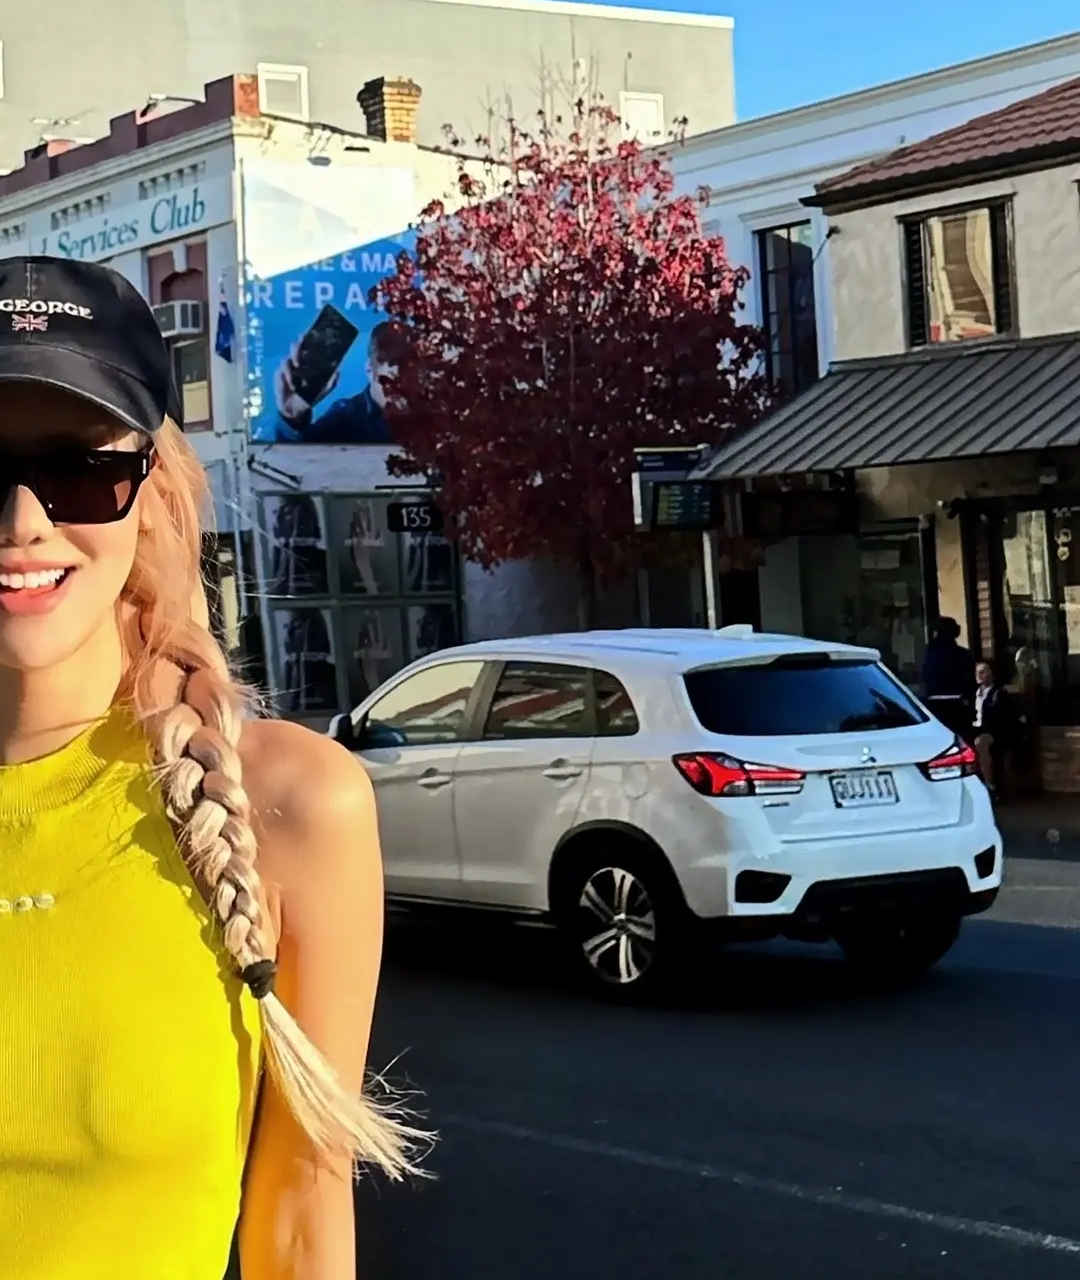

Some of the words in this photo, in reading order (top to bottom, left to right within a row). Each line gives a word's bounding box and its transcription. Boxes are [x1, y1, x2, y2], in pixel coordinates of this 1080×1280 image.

[57, 218, 139, 259] Services
[150, 186, 206, 235] Club
[360, 252, 398, 273] MA
[252, 280, 369, 311] REPA
[400, 507, 432, 527] 135
